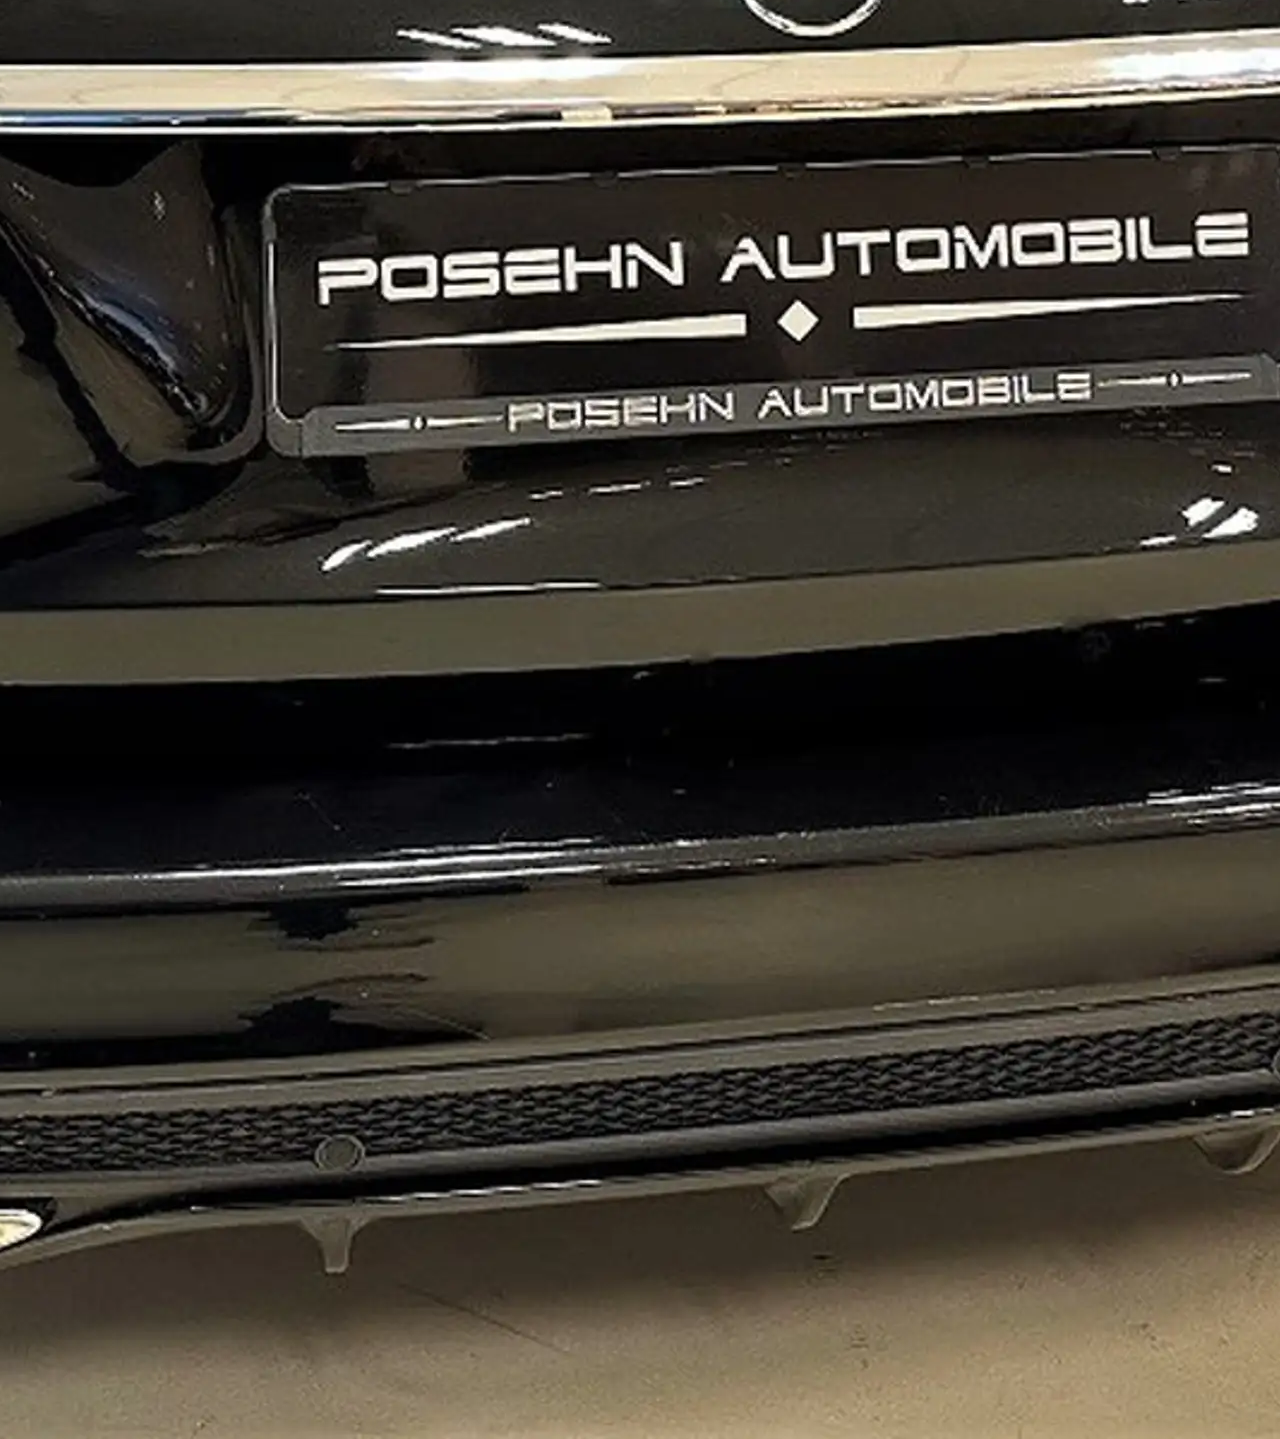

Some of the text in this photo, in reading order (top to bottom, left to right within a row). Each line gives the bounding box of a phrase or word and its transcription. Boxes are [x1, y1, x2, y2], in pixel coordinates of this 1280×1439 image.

[317, 212, 1250, 306] POSEHN AUTOMOBILE
[506, 372, 1094, 434] POSEHN AUTOMOBILE
